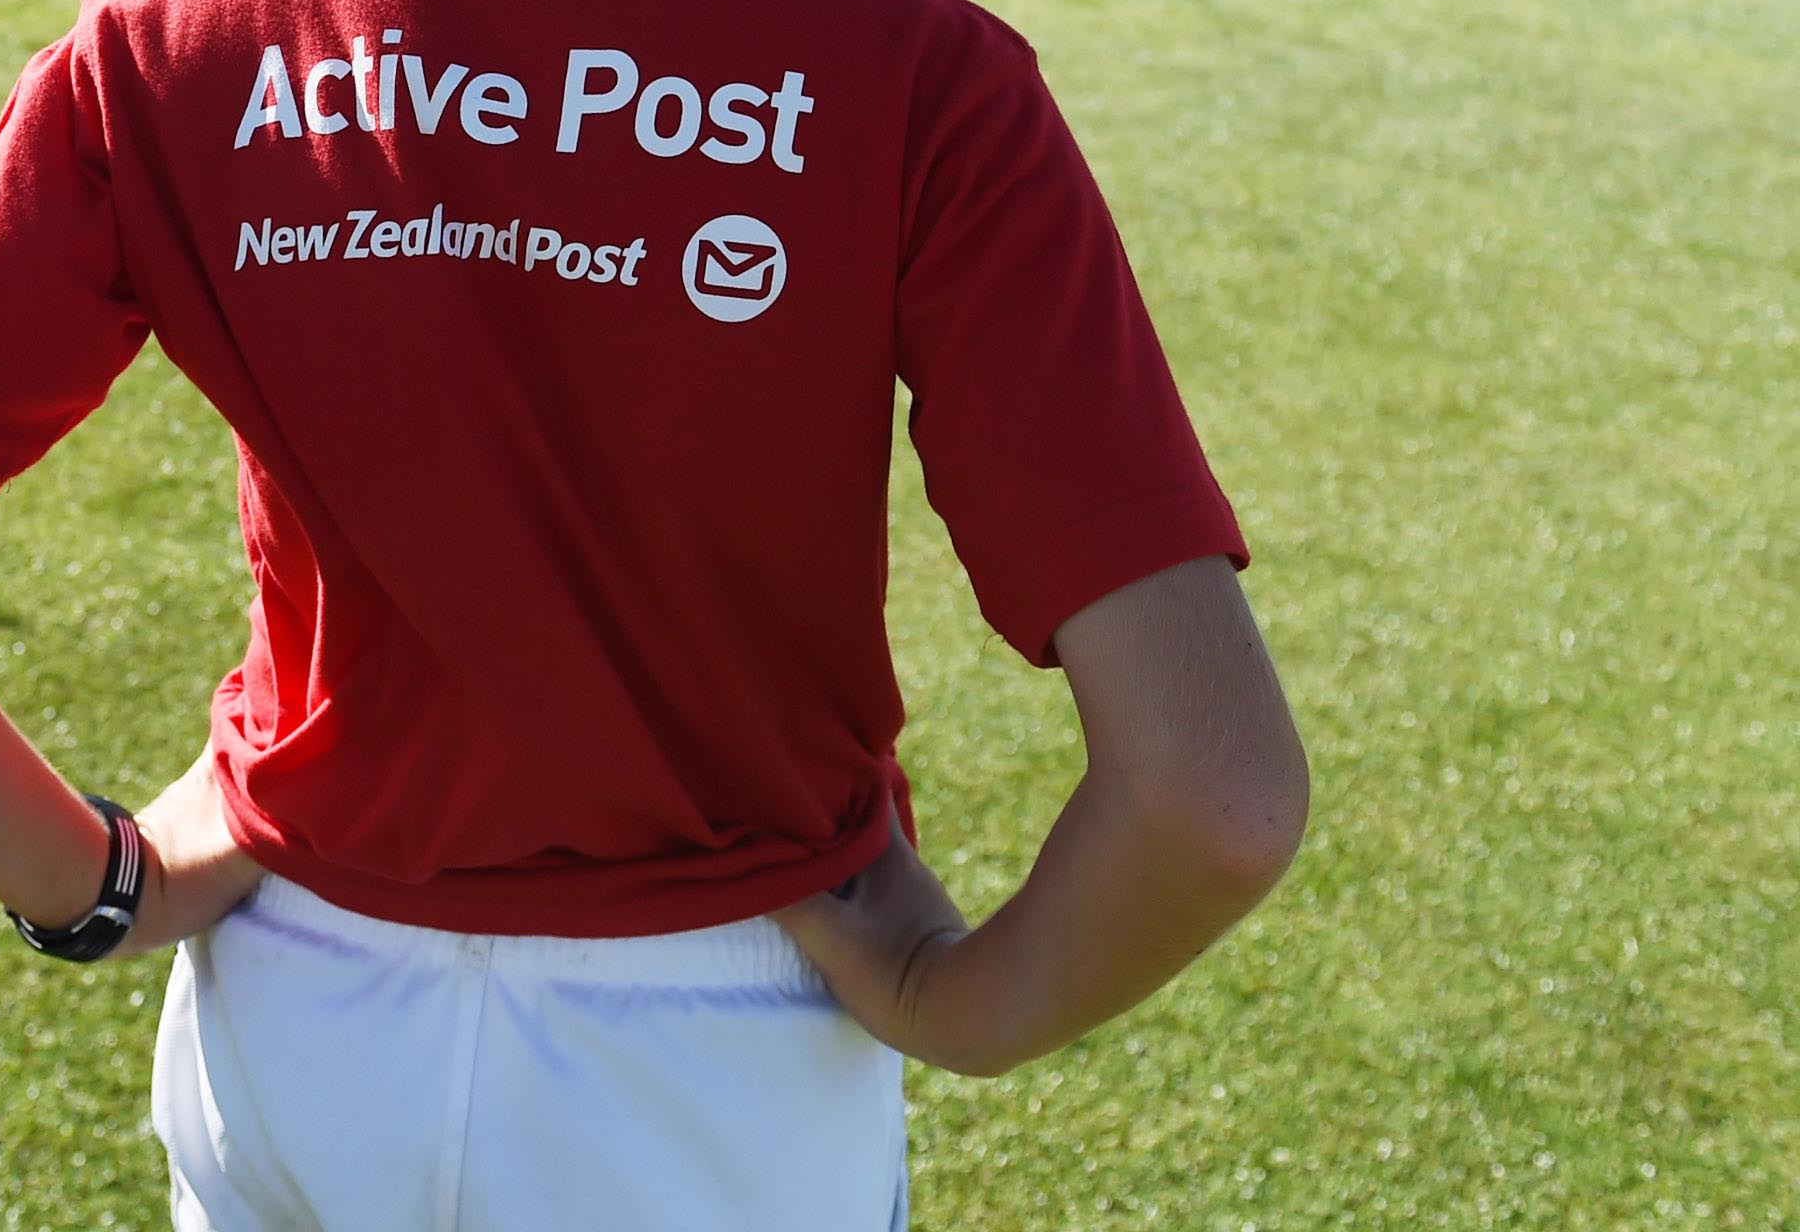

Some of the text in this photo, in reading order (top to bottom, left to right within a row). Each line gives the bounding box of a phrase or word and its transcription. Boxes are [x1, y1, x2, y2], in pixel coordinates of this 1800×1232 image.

[234, 28, 815, 174] Active Post
[234, 203, 648, 286] New Zealand Post
